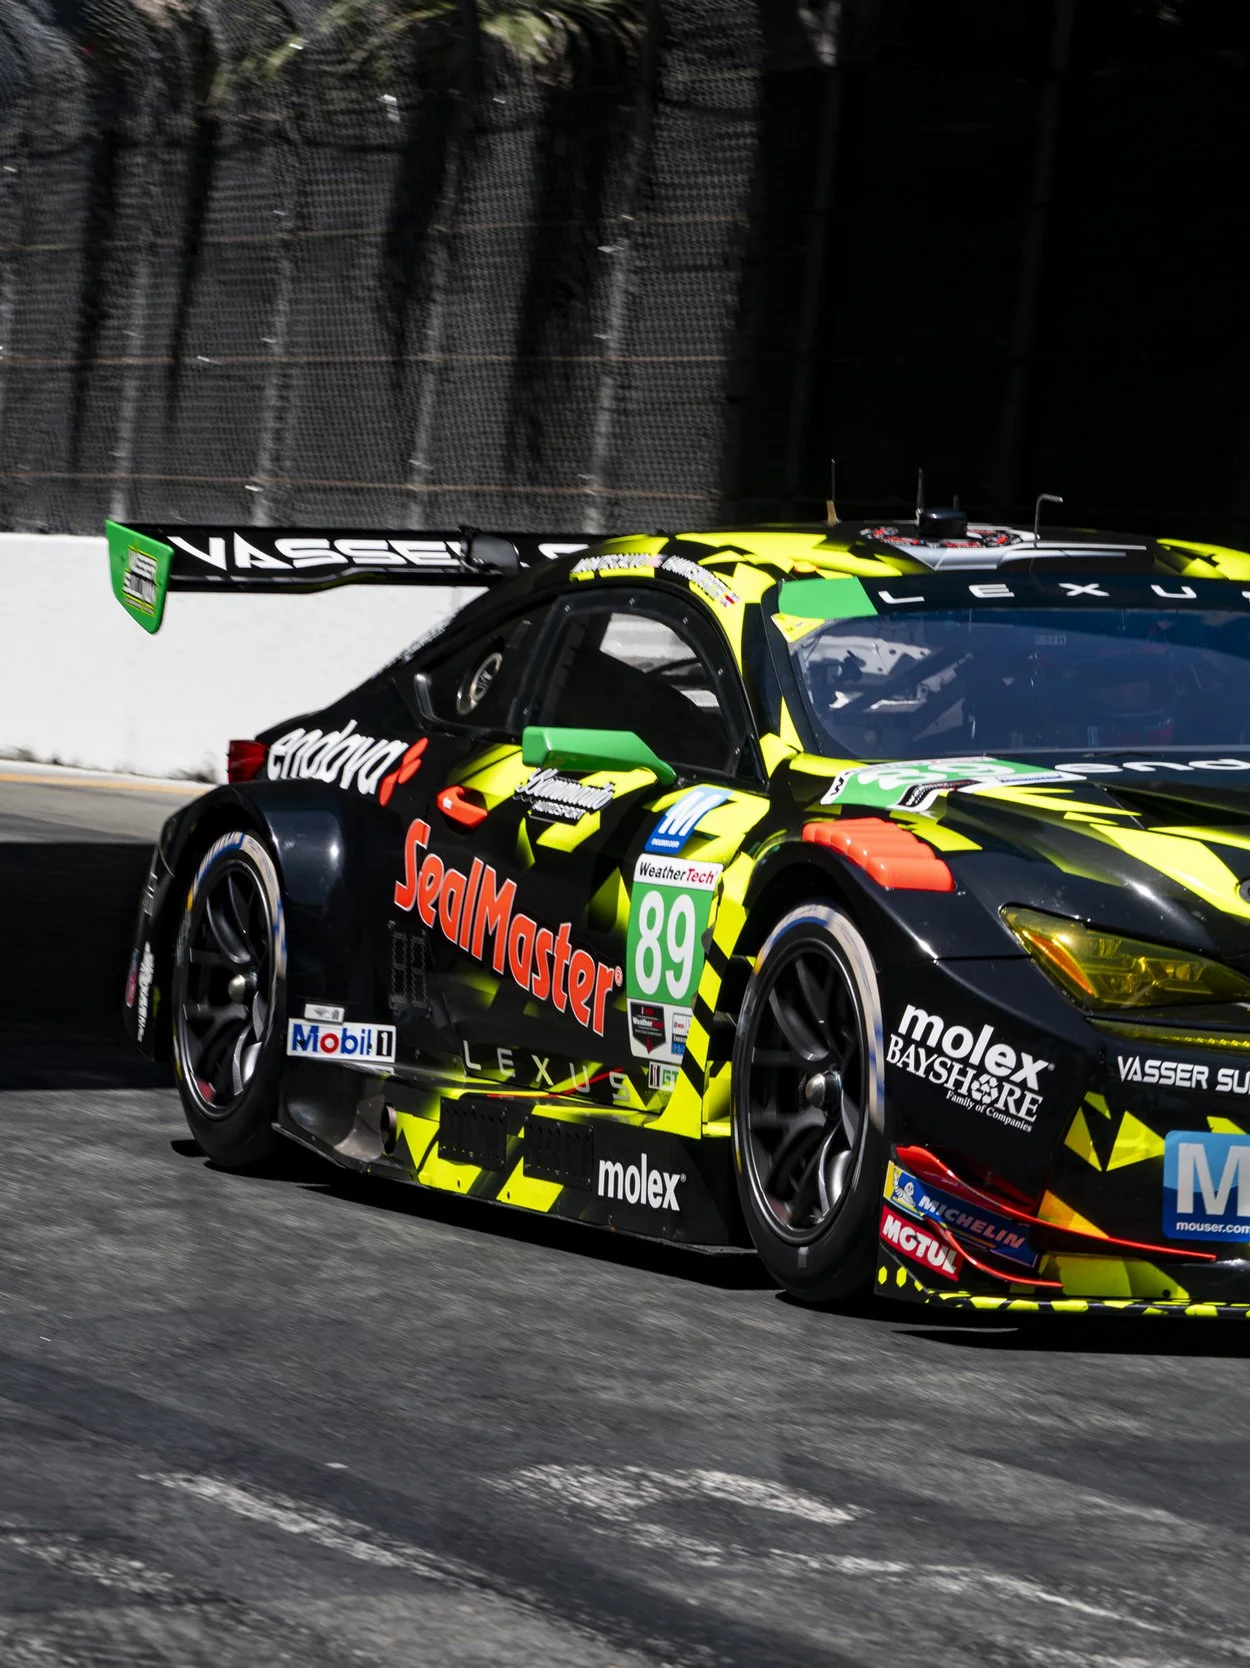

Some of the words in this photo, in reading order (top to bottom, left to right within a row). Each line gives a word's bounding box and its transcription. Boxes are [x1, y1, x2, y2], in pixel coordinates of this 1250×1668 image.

[266, 719, 410, 796] endava
[639, 861, 715, 885] WeatherTech
[393, 818, 615, 1037] SealMaster
[635, 890, 696, 1000] 89
[291, 1023, 373, 1055] Mobil
[898, 1003, 1050, 1091] molex
[463, 1040, 631, 1101] LEXUS
[1117, 1055, 1209, 1090] VASSER
[946, 1090, 975, 1110] Family
[975, 1103, 987, 1114] of
[986, 1106, 1033, 1133] Companies
[597, 1152, 681, 1212] molex
[882, 1214, 958, 1275] MOTUL
[918, 1195, 1026, 1249] MICHELIN
